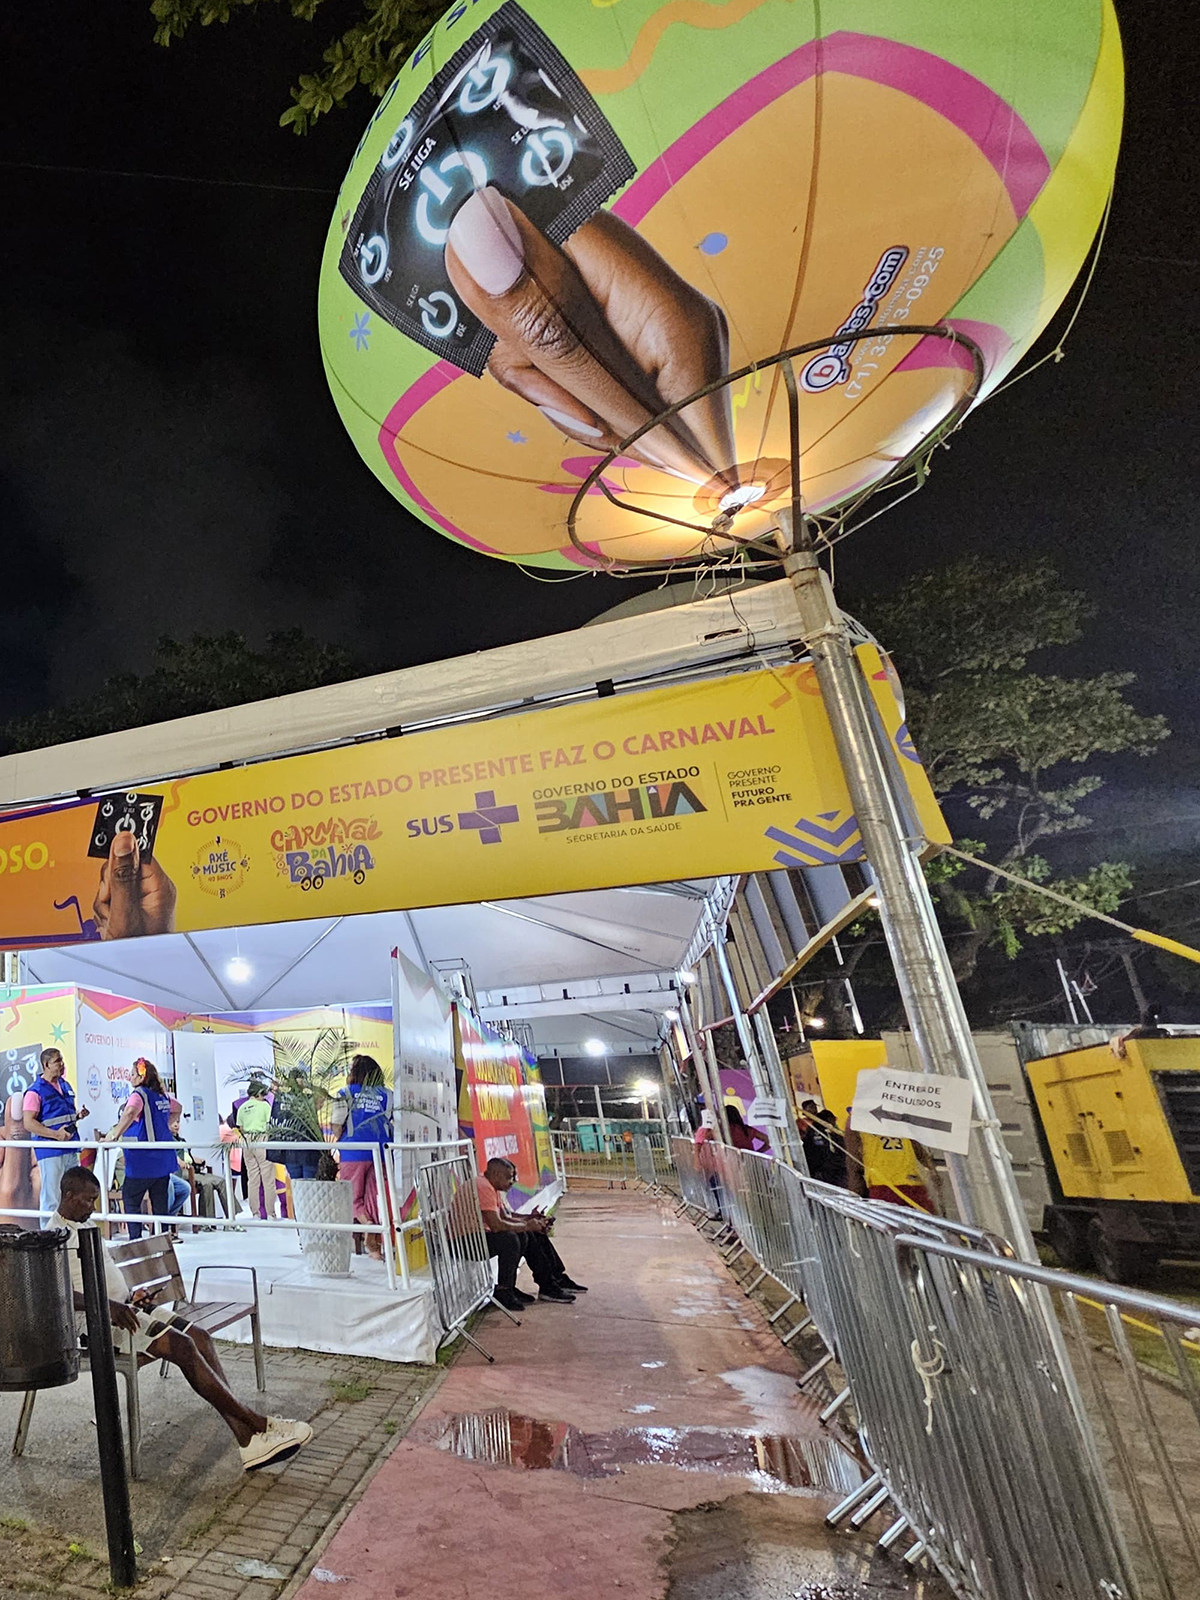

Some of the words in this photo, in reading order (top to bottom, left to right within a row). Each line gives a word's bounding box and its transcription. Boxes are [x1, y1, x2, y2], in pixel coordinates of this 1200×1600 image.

[398, 167, 416, 190] SE
[409, 137, 437, 172] LIGA
[186, 795, 286, 827] GOVERNO
[290, 789, 324, 811] DO
[328, 774, 414, 804] ESTADO
[419, 750, 534, 788] PRESENTE
[540, 744, 587, 772] FAZ
[593, 740, 616, 761] O
[623, 714, 775, 756] CARNAVAL
[726, 765, 782, 781] GOVERNO
[532, 780, 607, 800] GOVERNO
[611, 775, 634, 790] DO
[638, 765, 700, 785] ESTADO
[729, 774, 778, 788] PRESENTE
[731, 786, 775, 800] FUTURO
[733, 797, 756, 808] PRA
[757, 793, 793, 806] GENTE
[534, 781, 708, 834] BAHIA
[406, 814, 454, 839] SUS
[566, 829, 628, 844] SECRETARIA
[630, 827, 645, 836] DA
[646, 821, 683, 834] SAÚDE
[209, 849, 228, 863] AXÉ
[311, 848, 327, 860] DA
[203, 860, 236, 875] MUSIC
[84, 1033, 110, 1046] GOVERNO
[880, 1136, 904, 1150] 23
